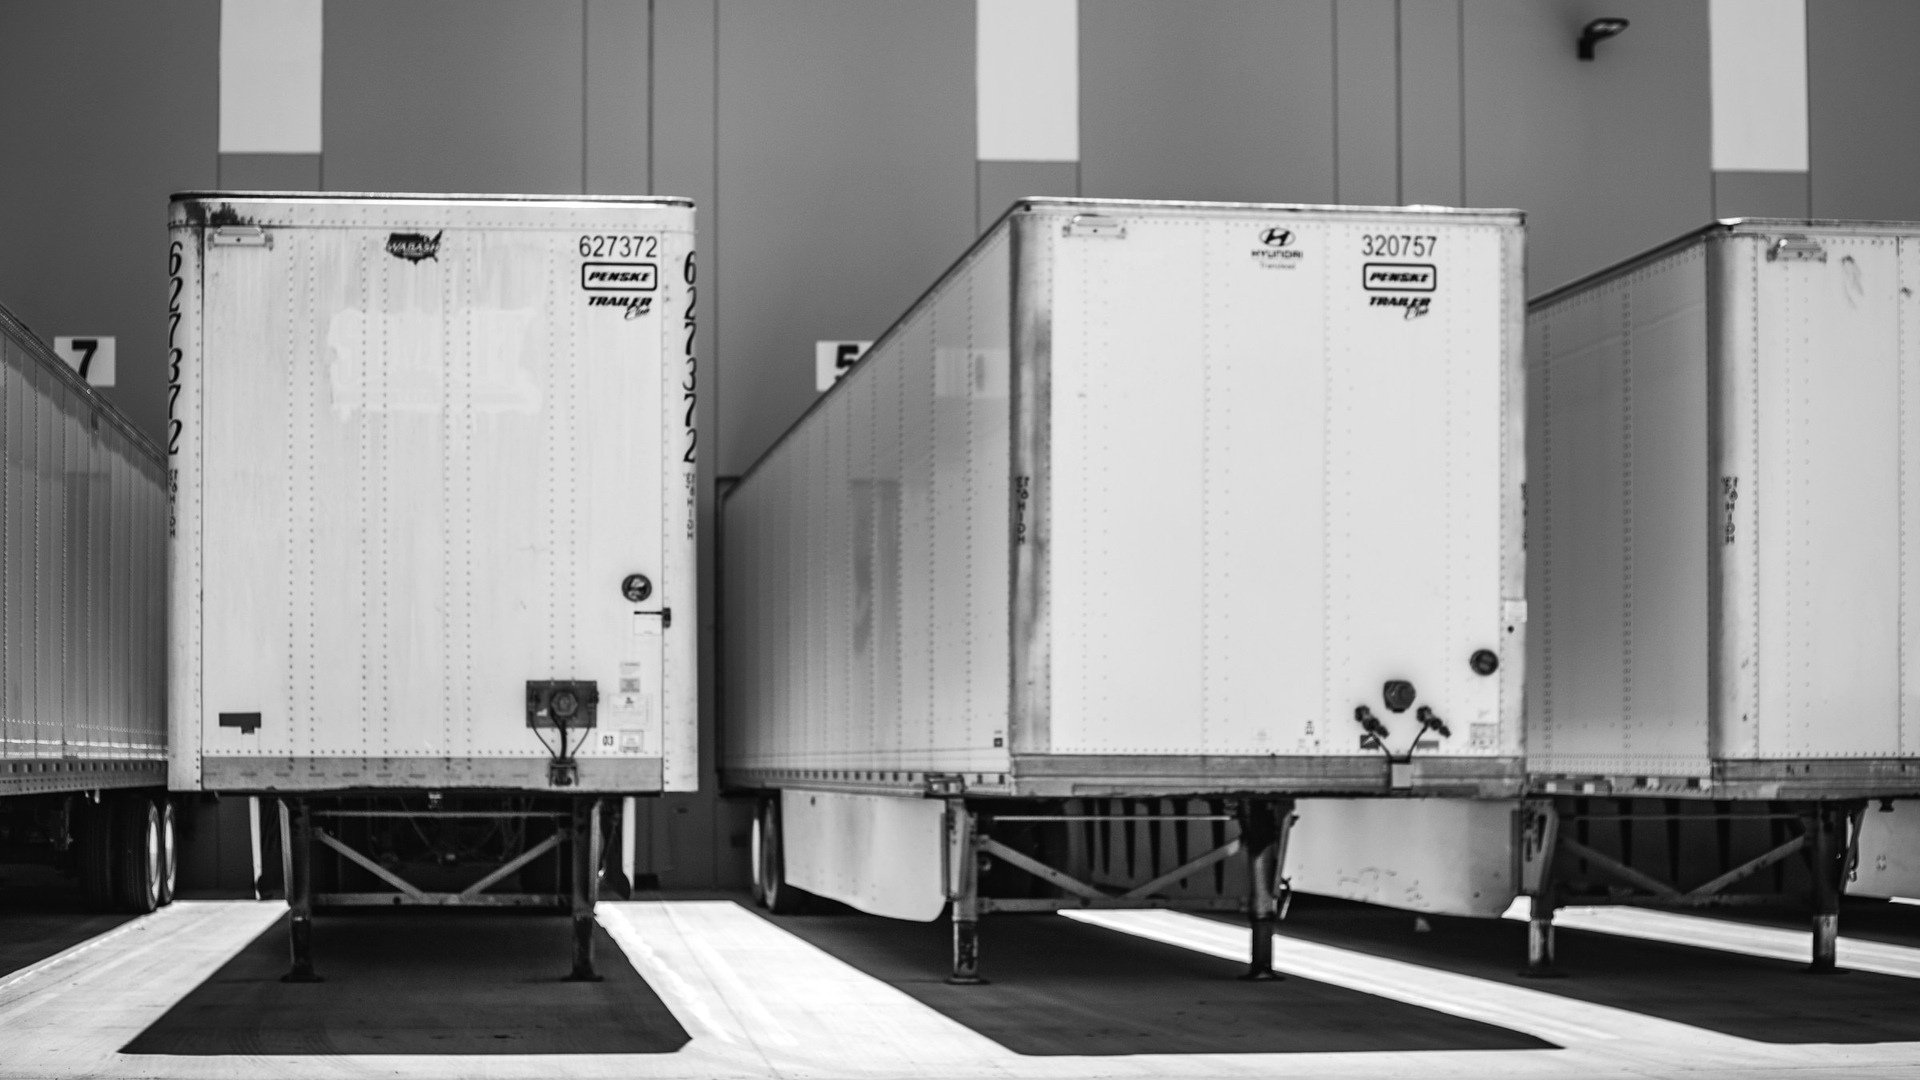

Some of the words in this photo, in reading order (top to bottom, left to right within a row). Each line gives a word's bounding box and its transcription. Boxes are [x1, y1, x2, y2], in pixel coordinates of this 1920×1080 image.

[386, 240, 441, 253] WABASH
[579, 235, 658, 258] 627372
[1361, 234, 1437, 257] 320757
[1251, 250, 1304, 258] HYUNDAI
[588, 271, 651, 282] PENSKE
[1369, 271, 1429, 283] PENSKE
[587, 295, 653, 307] TRAILER
[1369, 296, 1432, 307] TRAILER
[168, 240, 183, 456] 627372
[71, 339, 98, 381] 7
[683, 250, 697, 463] 627372
